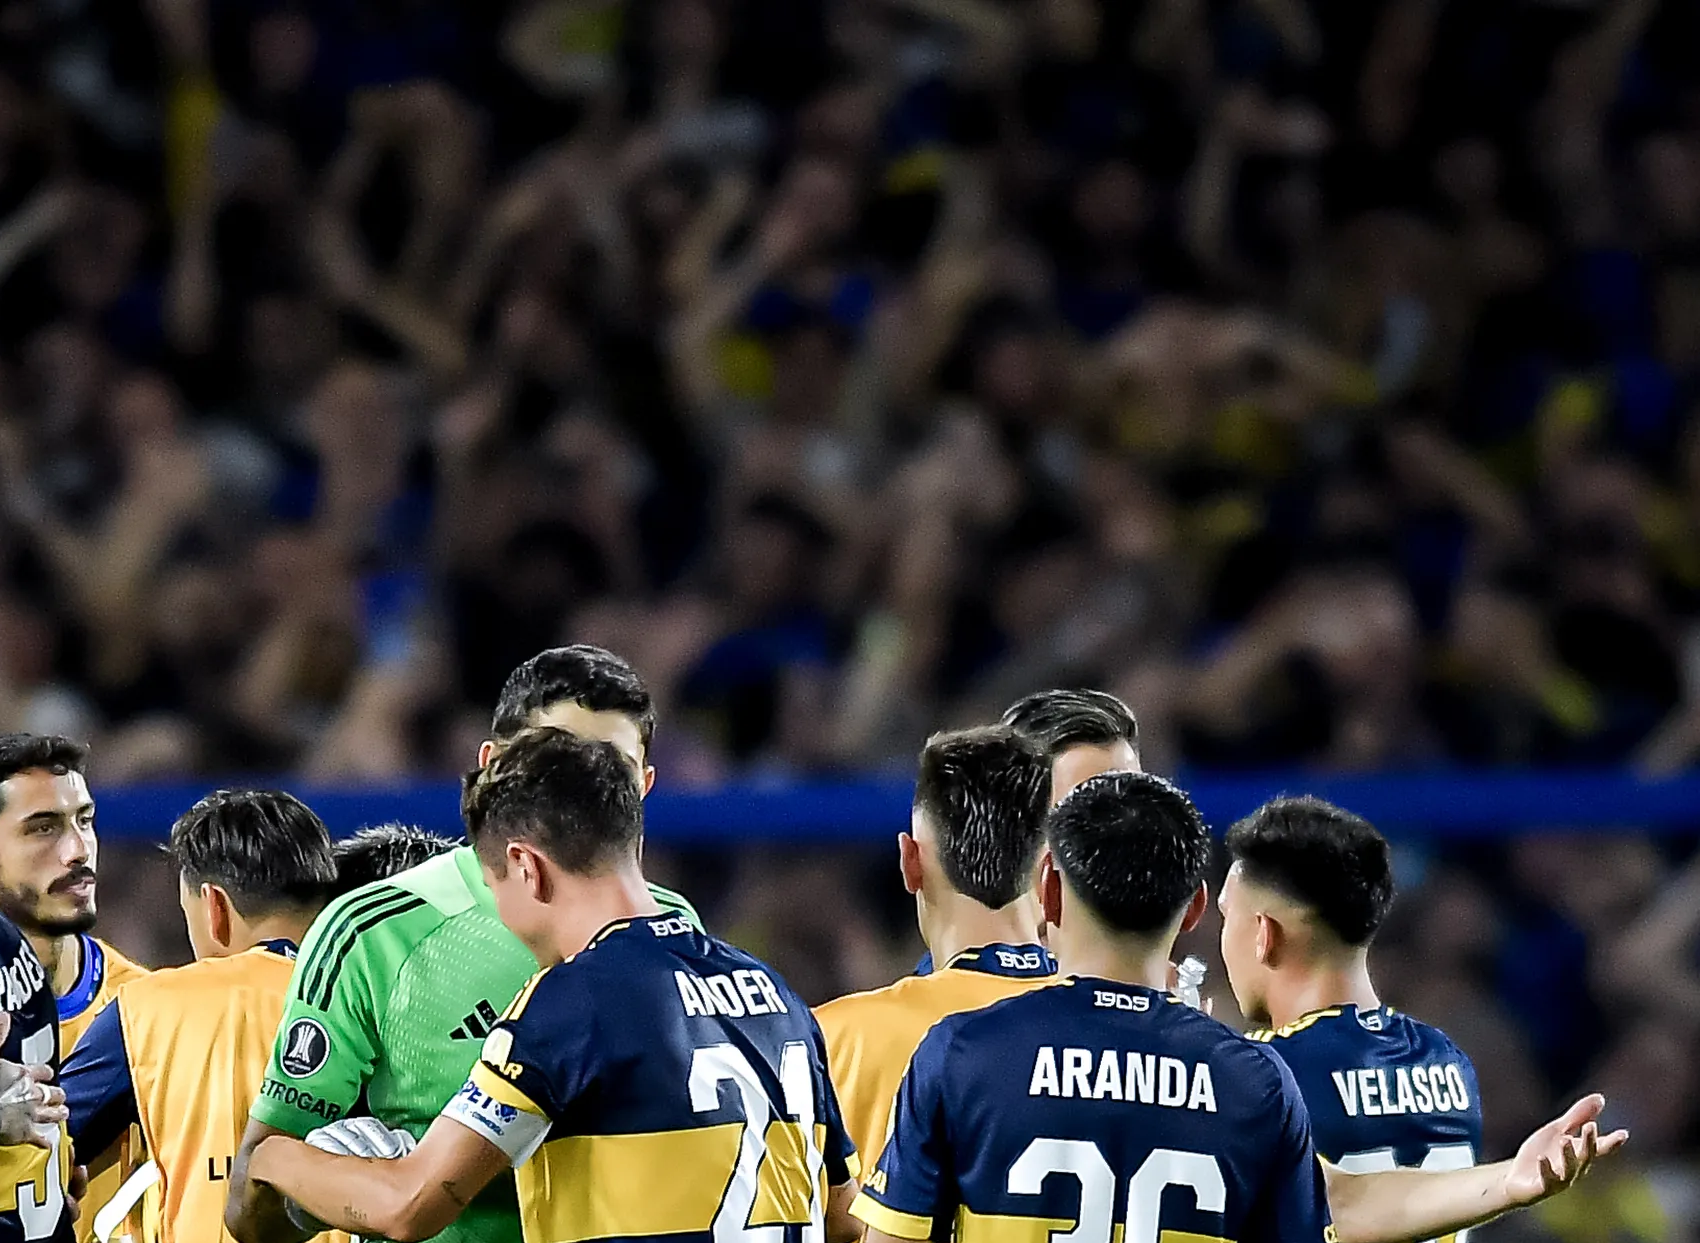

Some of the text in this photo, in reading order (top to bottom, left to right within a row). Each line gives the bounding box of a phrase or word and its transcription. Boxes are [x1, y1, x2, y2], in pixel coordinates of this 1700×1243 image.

[674, 969, 789, 1018] ANDER
[1093, 990, 1150, 1012] 1905
[1029, 1046, 1218, 1113] ARANDA
[1331, 1063, 1470, 1116] VELASCO
